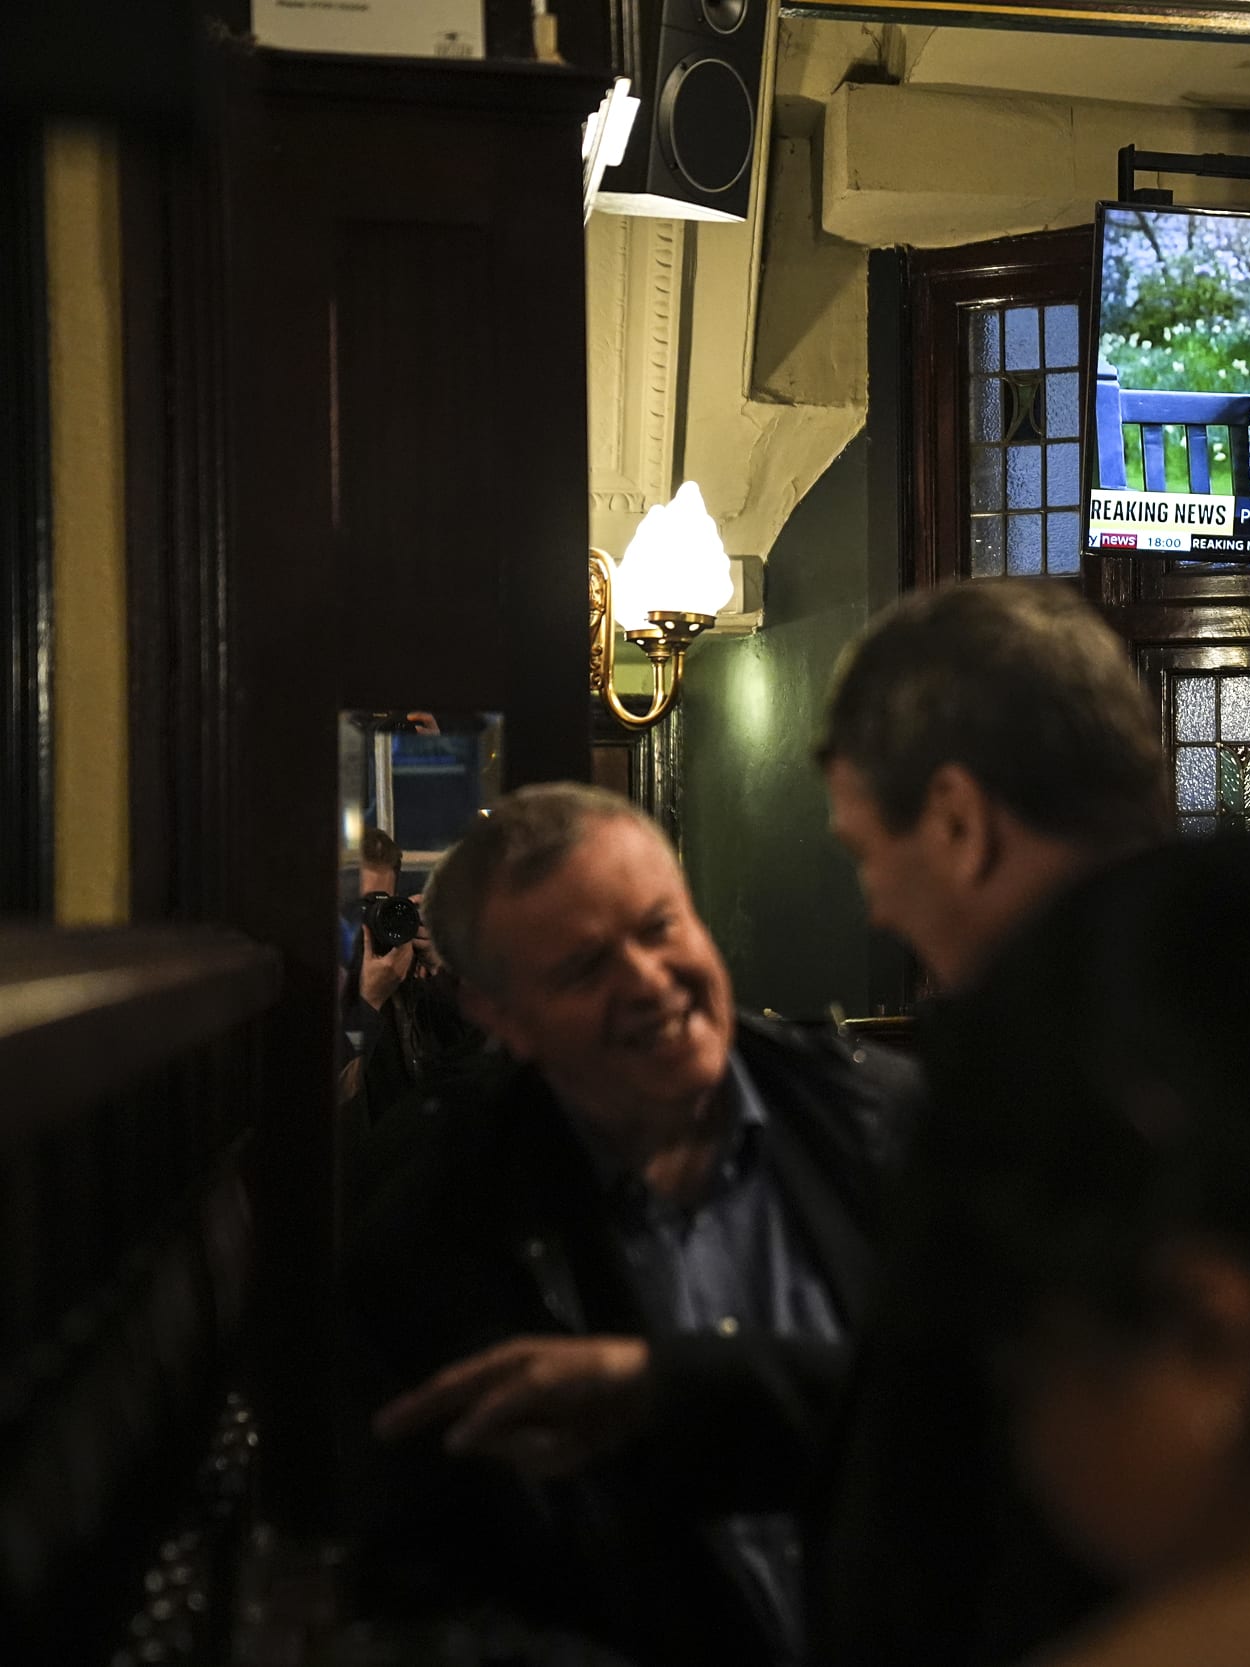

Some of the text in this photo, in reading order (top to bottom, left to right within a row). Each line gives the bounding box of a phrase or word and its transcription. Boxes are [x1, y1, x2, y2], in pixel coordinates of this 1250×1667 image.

[1091, 499, 1227, 525] REAKING NEWS
[1101, 534, 1136, 547] news
[1148, 537, 1181, 548] 18:00
[1192, 538, 1244, 551] REAKING
